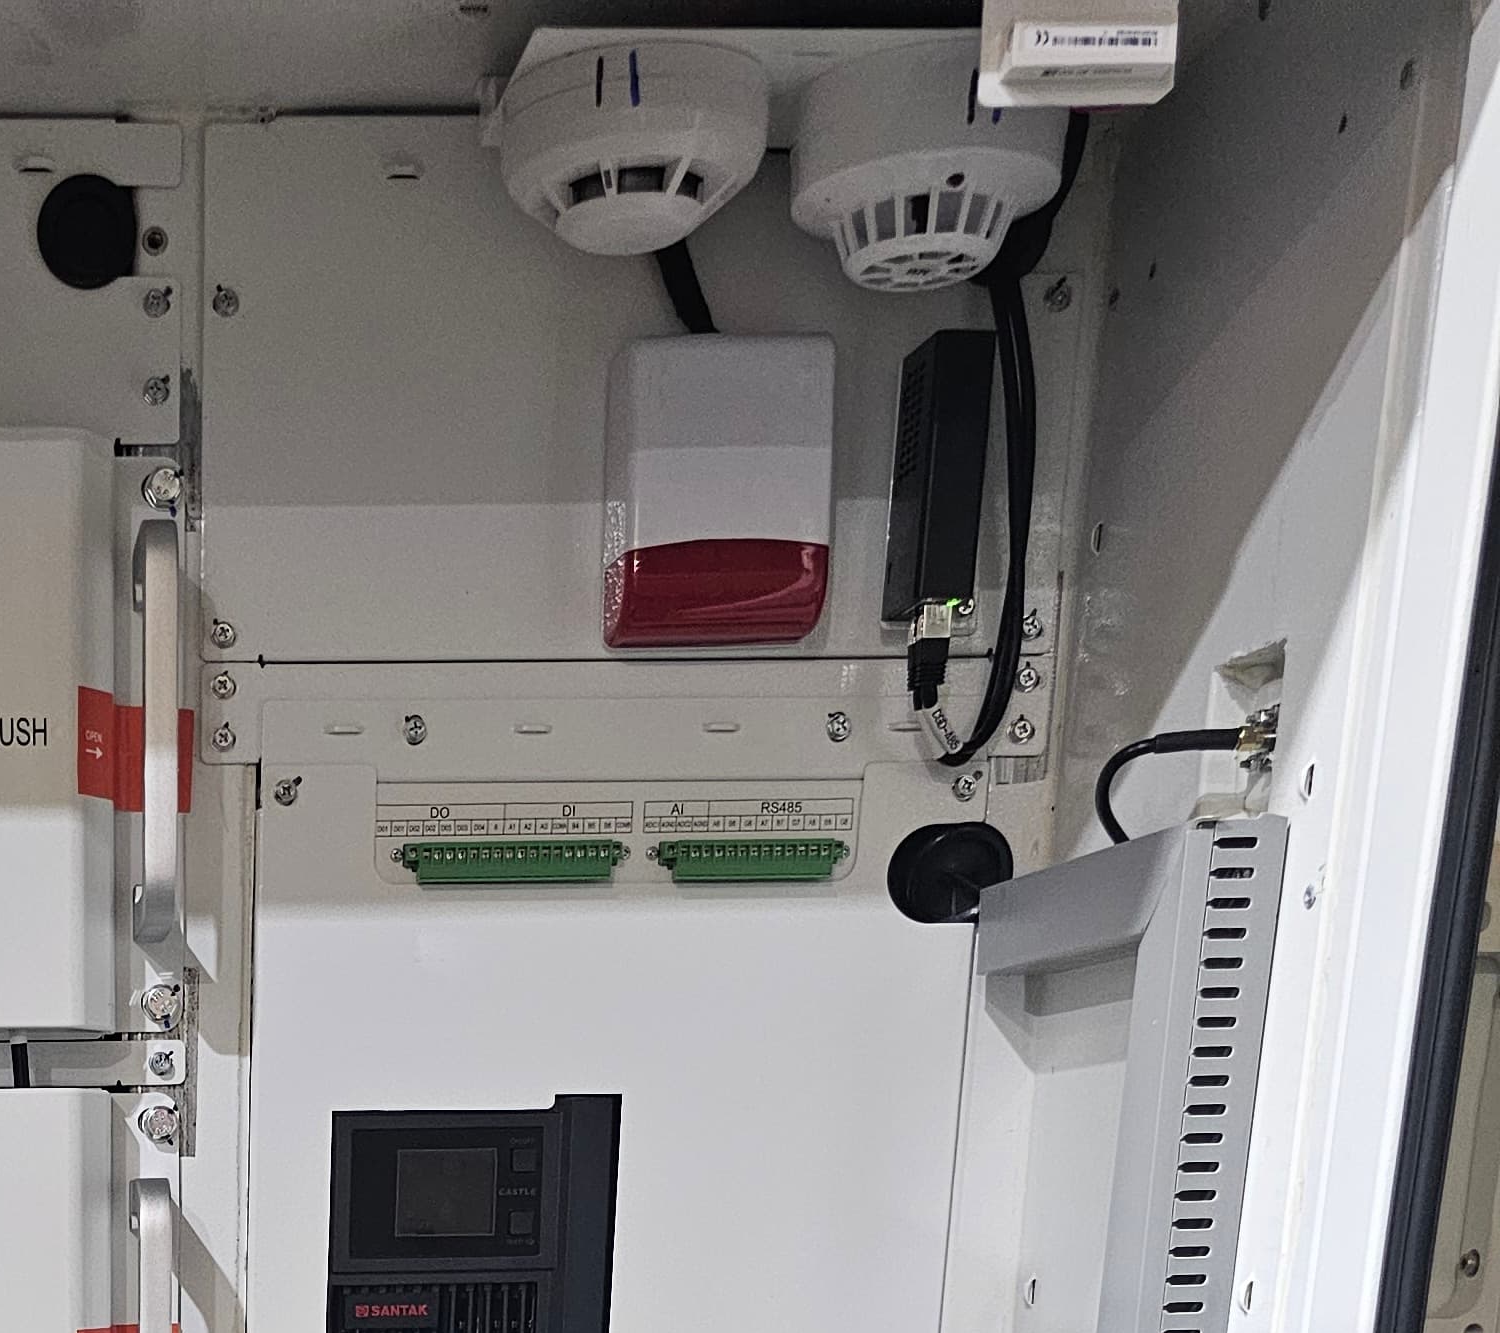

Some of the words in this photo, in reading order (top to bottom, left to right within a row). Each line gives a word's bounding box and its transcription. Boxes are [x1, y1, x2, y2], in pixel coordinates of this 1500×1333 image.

[85, 730, 102, 744] OPEN
[563, 805, 576, 817] DI
[670, 803, 684, 815] AI
[761, 801, 802, 813] RS485
[498, 1187, 537, 1196] CASTLE
[371, 1304, 429, 1318] SANTAK
